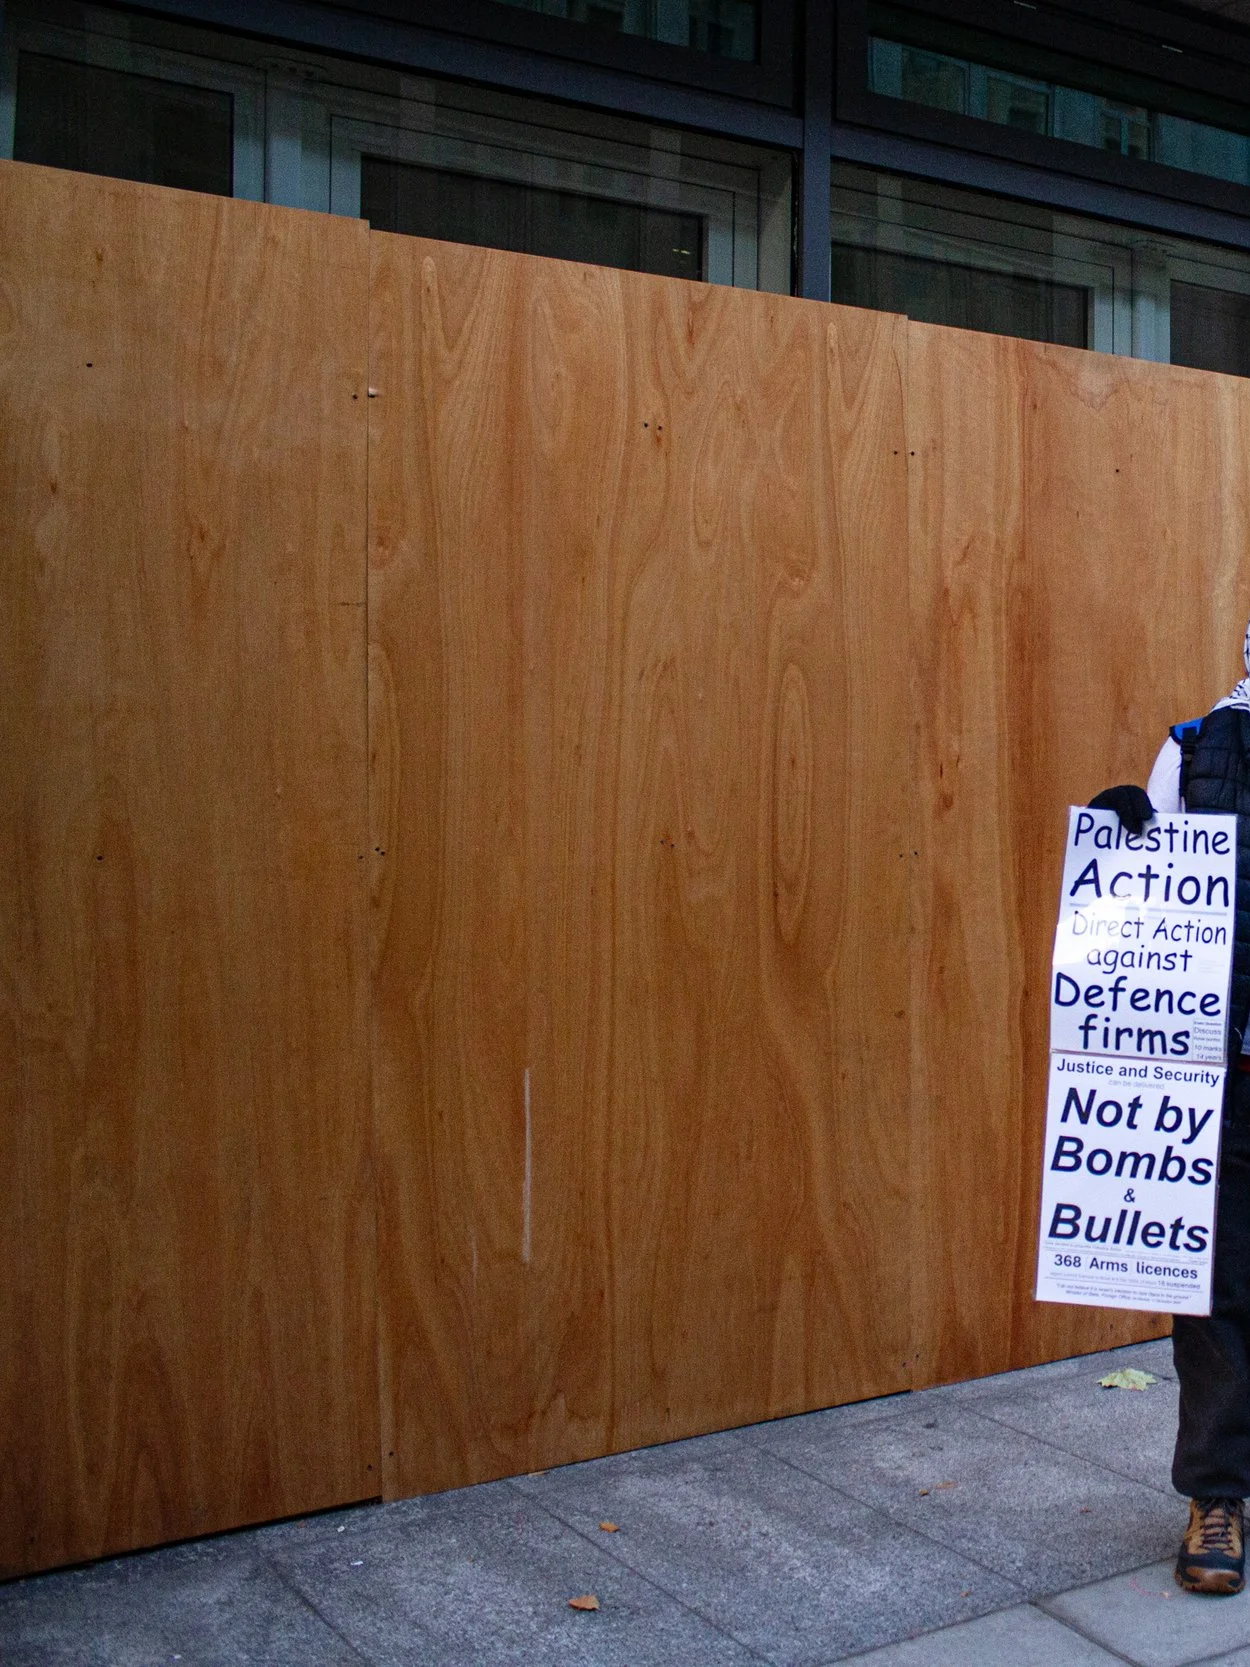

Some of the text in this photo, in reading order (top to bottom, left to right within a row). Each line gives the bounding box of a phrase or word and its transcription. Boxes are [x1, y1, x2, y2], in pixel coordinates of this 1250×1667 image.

[1074, 813, 1230, 855] Palestine
[1070, 858, 1229, 907] Action
[1072, 911, 1226, 944] Direct Action
[1087, 945, 1192, 974] against
[1055, 972, 1221, 1016] Defence
[1079, 1014, 1190, 1055] firms
[1057, 1059, 1219, 1087] Justice and Security
[1060, 1087, 1214, 1145] Not by
[1051, 1136, 1214, 1185] Bombs
[1124, 1188, 1136, 1203] &
[1049, 1203, 1209, 1252] Bullets
[1054, 1254, 1081, 1268] 368
[1089, 1256, 1128, 1273] Arms
[1136, 1262, 1197, 1279] licences
